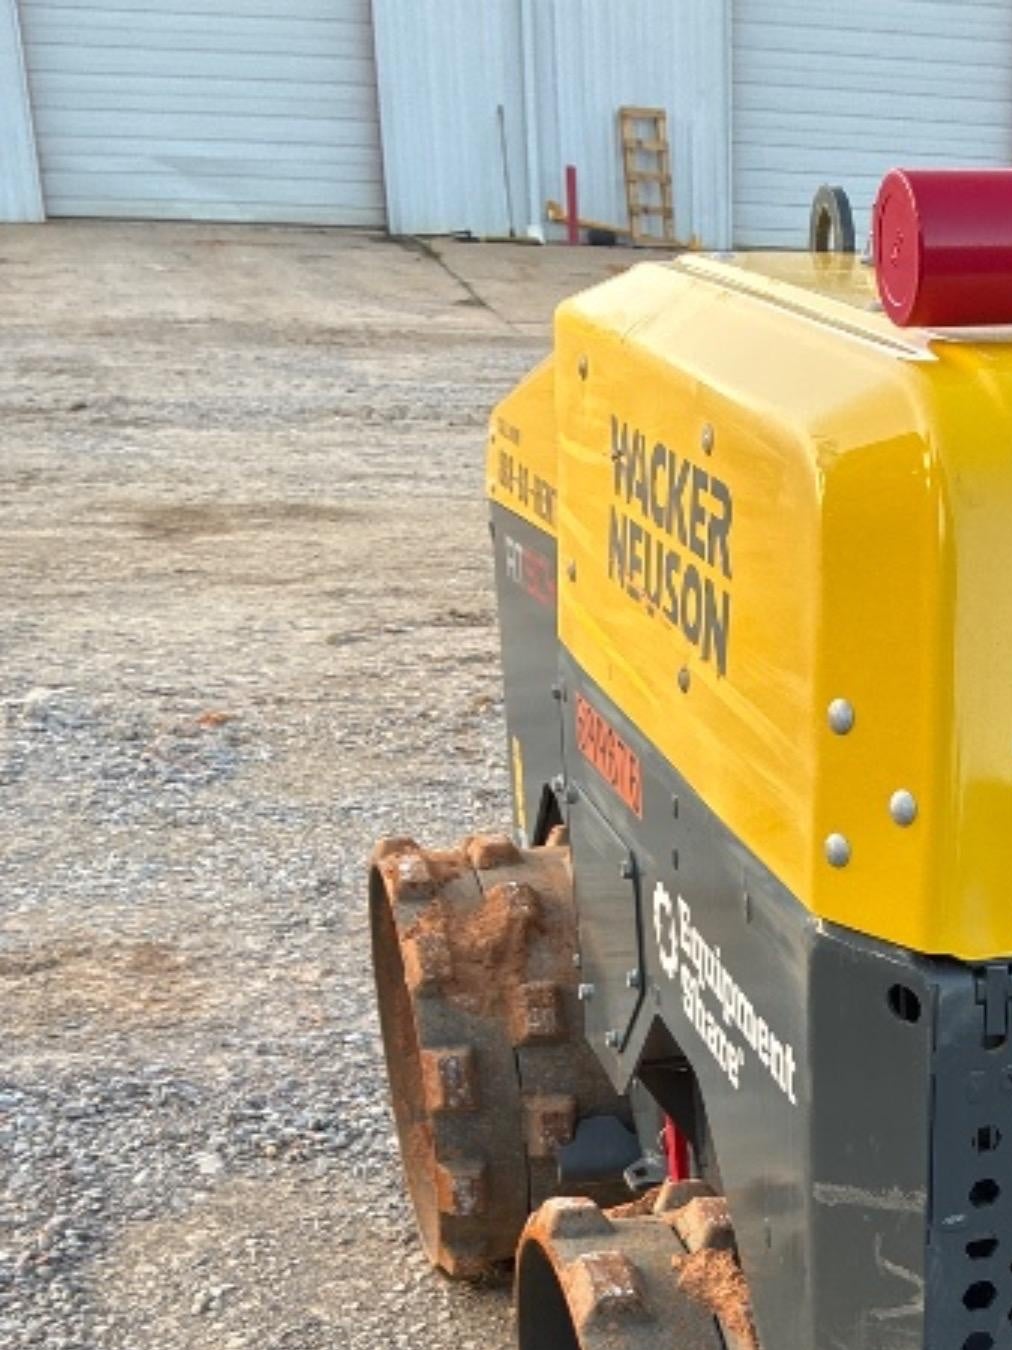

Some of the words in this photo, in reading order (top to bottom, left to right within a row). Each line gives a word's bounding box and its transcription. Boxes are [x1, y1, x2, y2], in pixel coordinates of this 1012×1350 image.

[610, 414, 732, 581] WACKER
[608, 504, 730, 680] NEUSON
[677, 892, 797, 1106] Equipment
[680, 963, 745, 1091] Share
